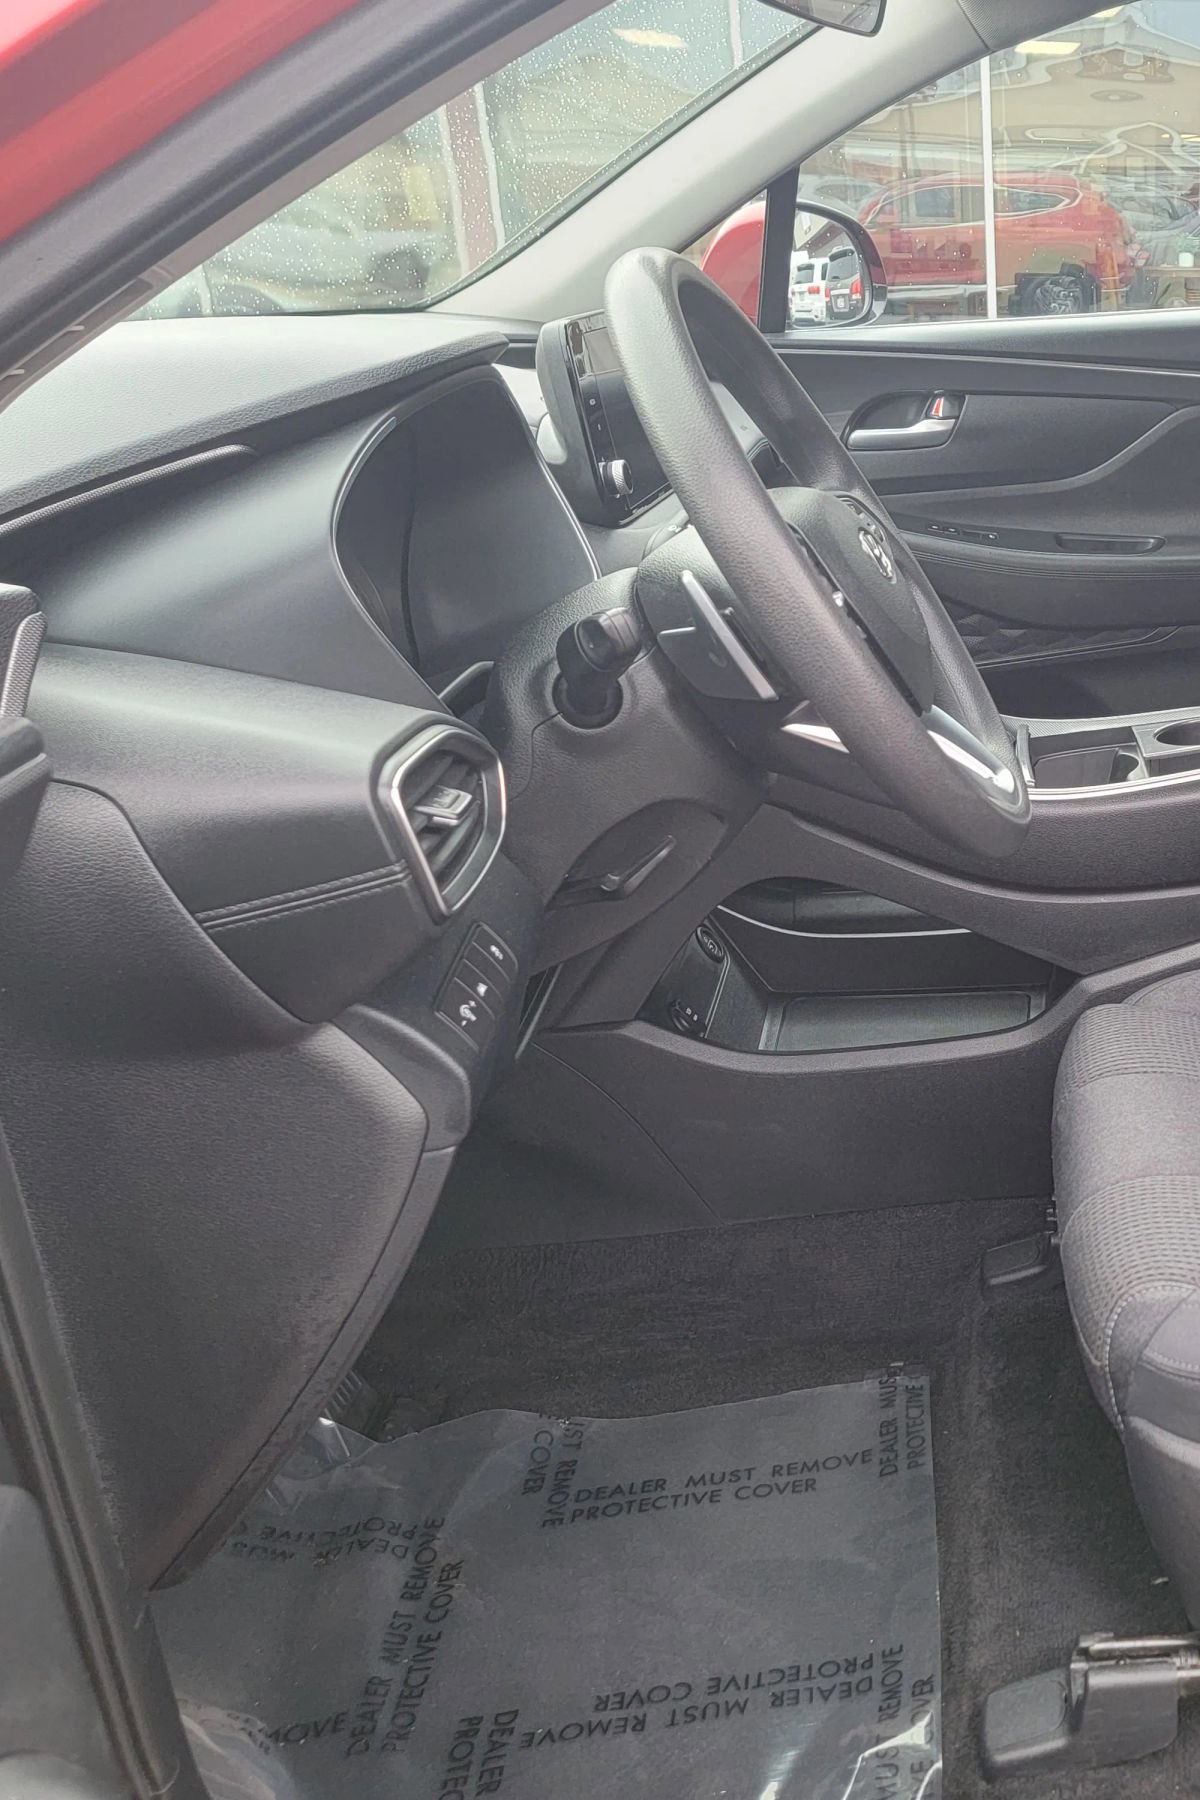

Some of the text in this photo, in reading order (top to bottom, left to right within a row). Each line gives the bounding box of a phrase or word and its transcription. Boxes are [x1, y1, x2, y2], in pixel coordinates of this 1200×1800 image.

[521, 1430, 554, 1495] COVER
[879, 1377, 898, 1477] DEALER MUS
[905, 1384, 926, 1469] PROTECTIVE
[542, 1459, 578, 1528] REMOVE
[569, 1478, 817, 1525] PROTECTIVE COVER
[574, 1448, 873, 1504] DEALER MUST REMOVE
[344, 1517, 446, 1760] DEALER MUST REMOVE
[381, 1559, 465, 1753] PROTECTIVE COVER
[519, 1675, 873, 1749] DEALER MUST REMOVE
[591, 1652, 874, 1713] PROTECTIVE COVER
[877, 1643, 904, 1723] REMOVE
[475, 1708, 520, 1799] DEALER
